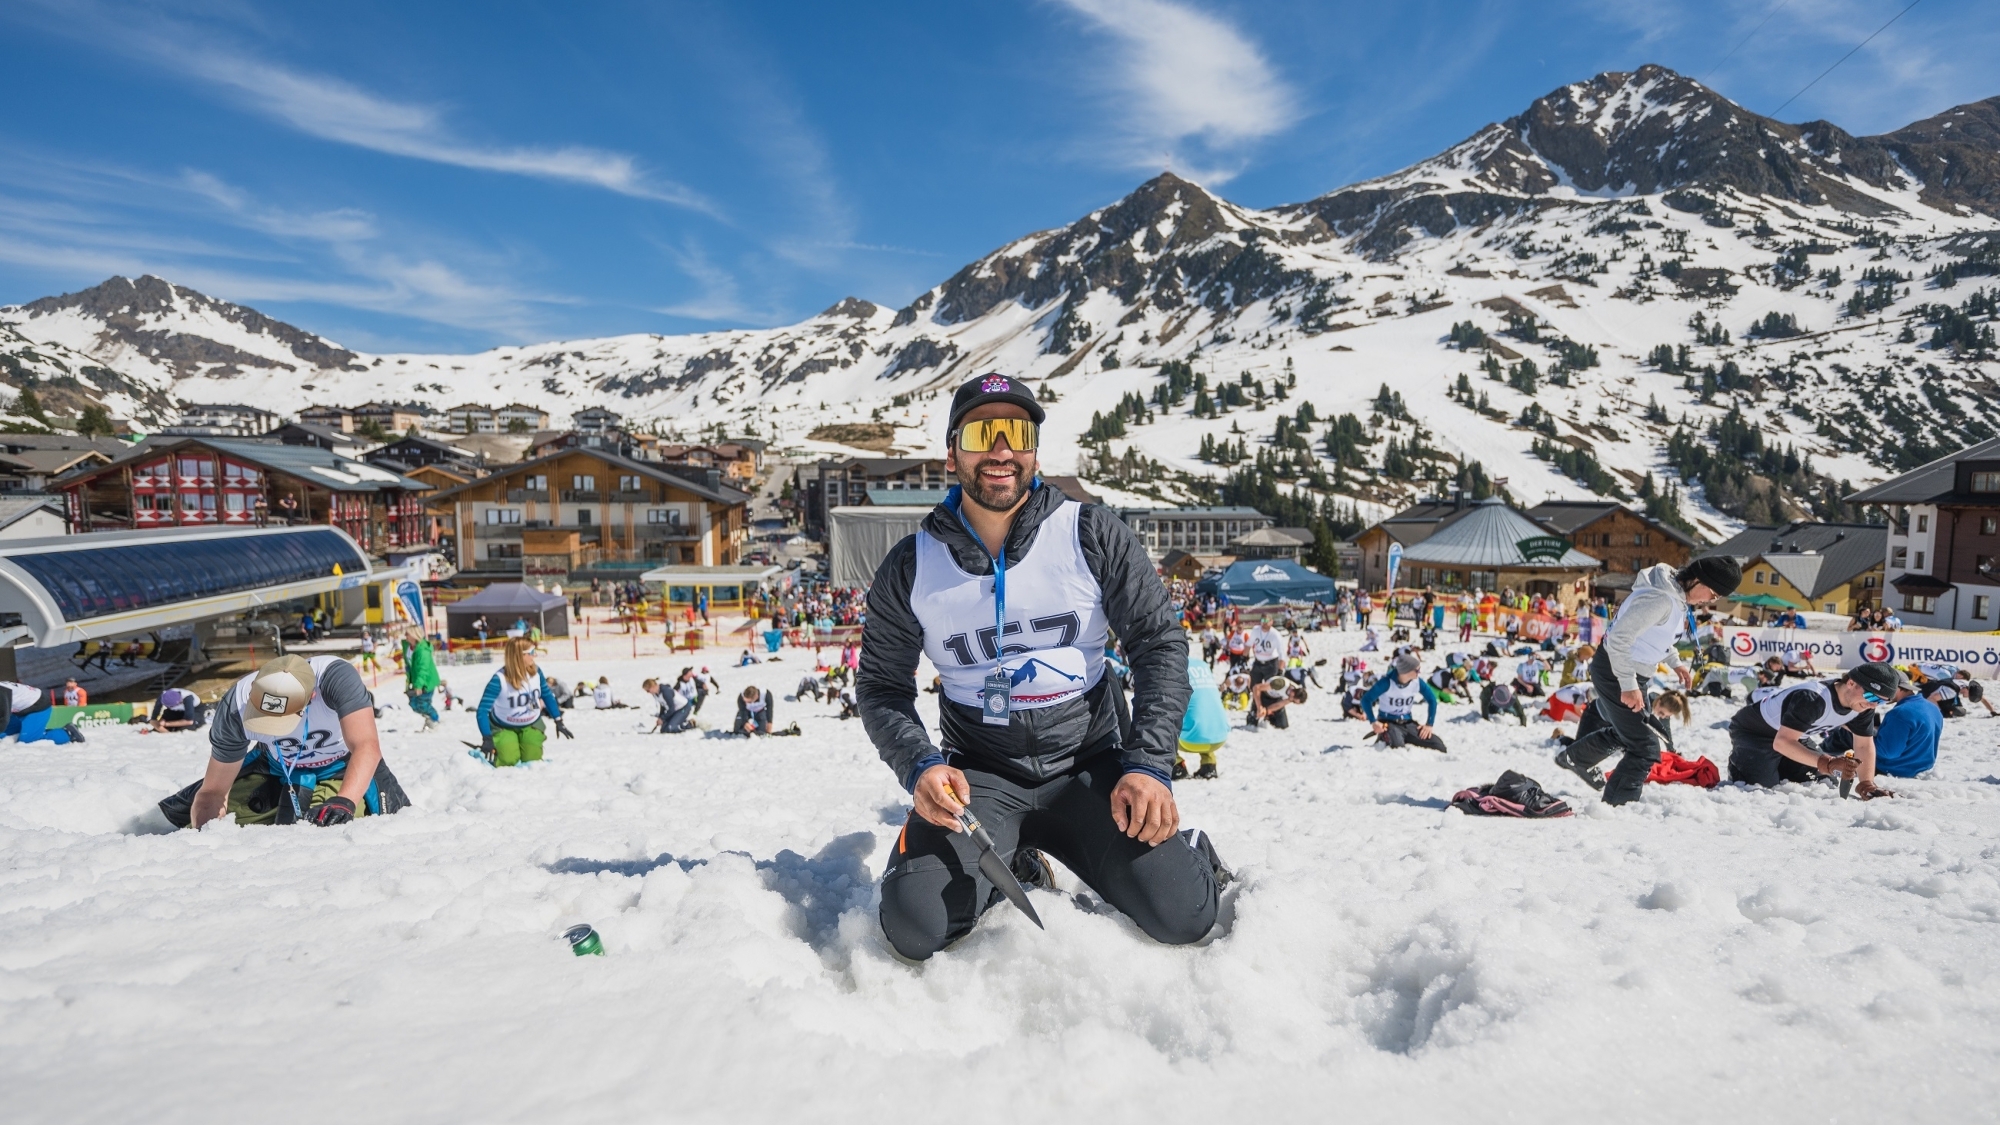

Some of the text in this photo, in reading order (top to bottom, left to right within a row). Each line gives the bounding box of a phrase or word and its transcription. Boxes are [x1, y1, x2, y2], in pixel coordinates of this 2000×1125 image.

[943, 610, 1081, 666] 157
[1760, 640, 1820, 655] HITRADIO
[1823, 640, 1843, 656] Ö3
[1898, 647, 1980, 664] HITRADIO
[1983, 648, 2000, 665] Ö
[1389, 696, 1414, 707] 190
[72, 711, 120, 729] Gösser
